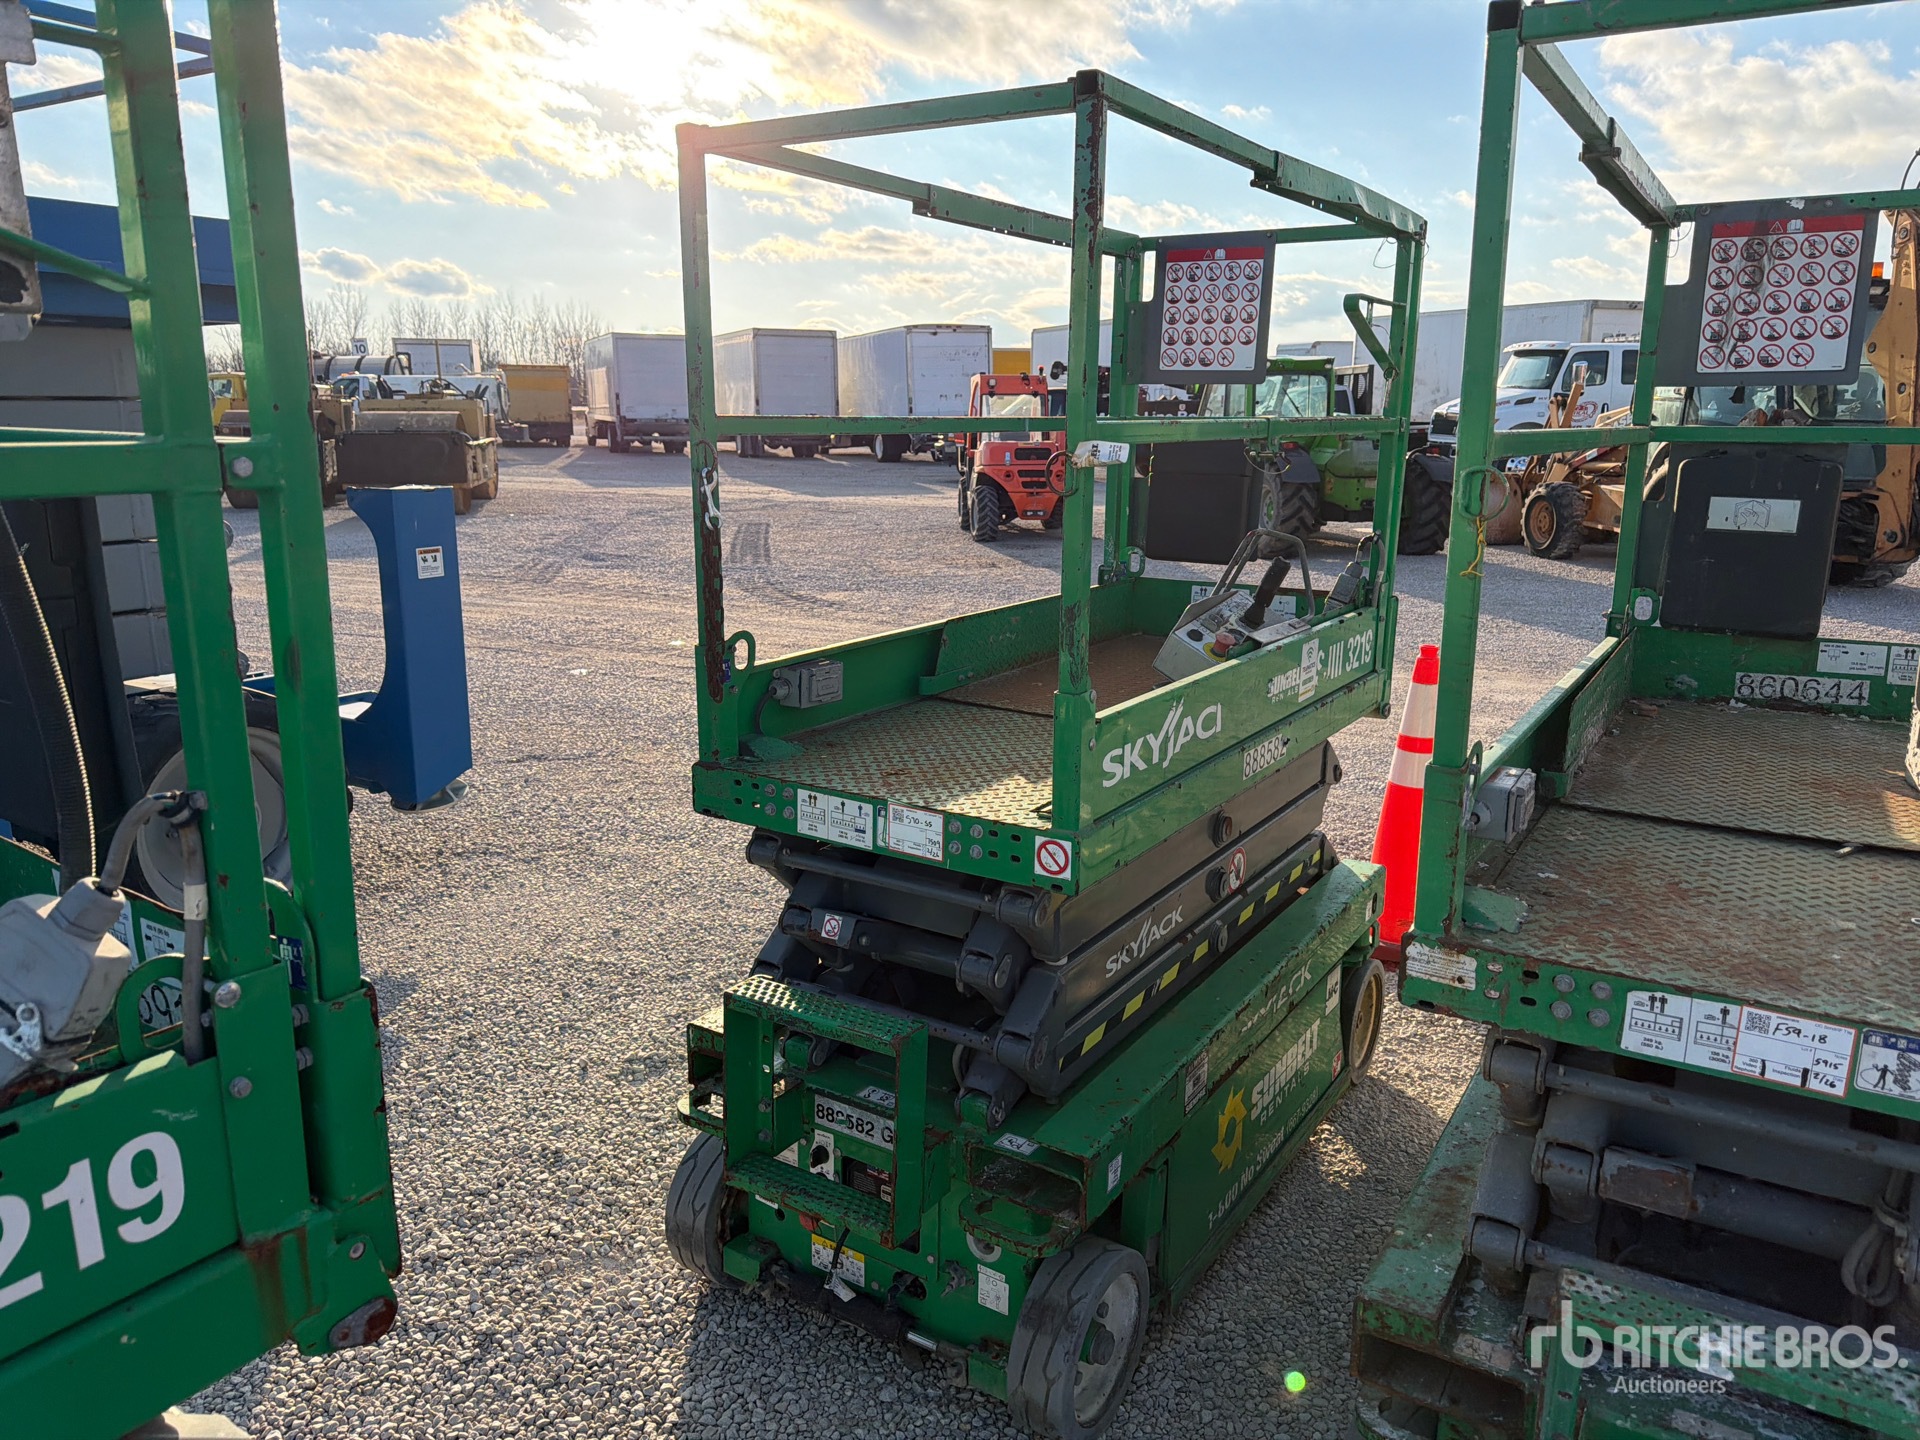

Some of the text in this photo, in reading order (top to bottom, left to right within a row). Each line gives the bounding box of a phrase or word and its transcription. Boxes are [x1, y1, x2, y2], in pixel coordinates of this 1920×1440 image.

[354, 344, 366, 354] 10
[1345, 629, 1373, 672] 3219
[1267, 667, 1301, 698] SUNBEL
[1271, 685, 1299, 704] RENALS
[1737, 673, 1867, 706] 860644
[1105, 905, 1183, 979] SKYJACK
[1250, 1017, 1321, 1121] SUNBELT
[1742, 1061, 1758, 1069] Video
[1772, 1068, 1801, 1079] Inspection
[1813, 1058, 1844, 1070] 5915
[1813, 1072, 1837, 1089] 2/26
[1241, 1165, 1254, 1192] No
[1256, 1126, 1284, 1171] Sweat
[0, 1131, 185, 1310] 219
